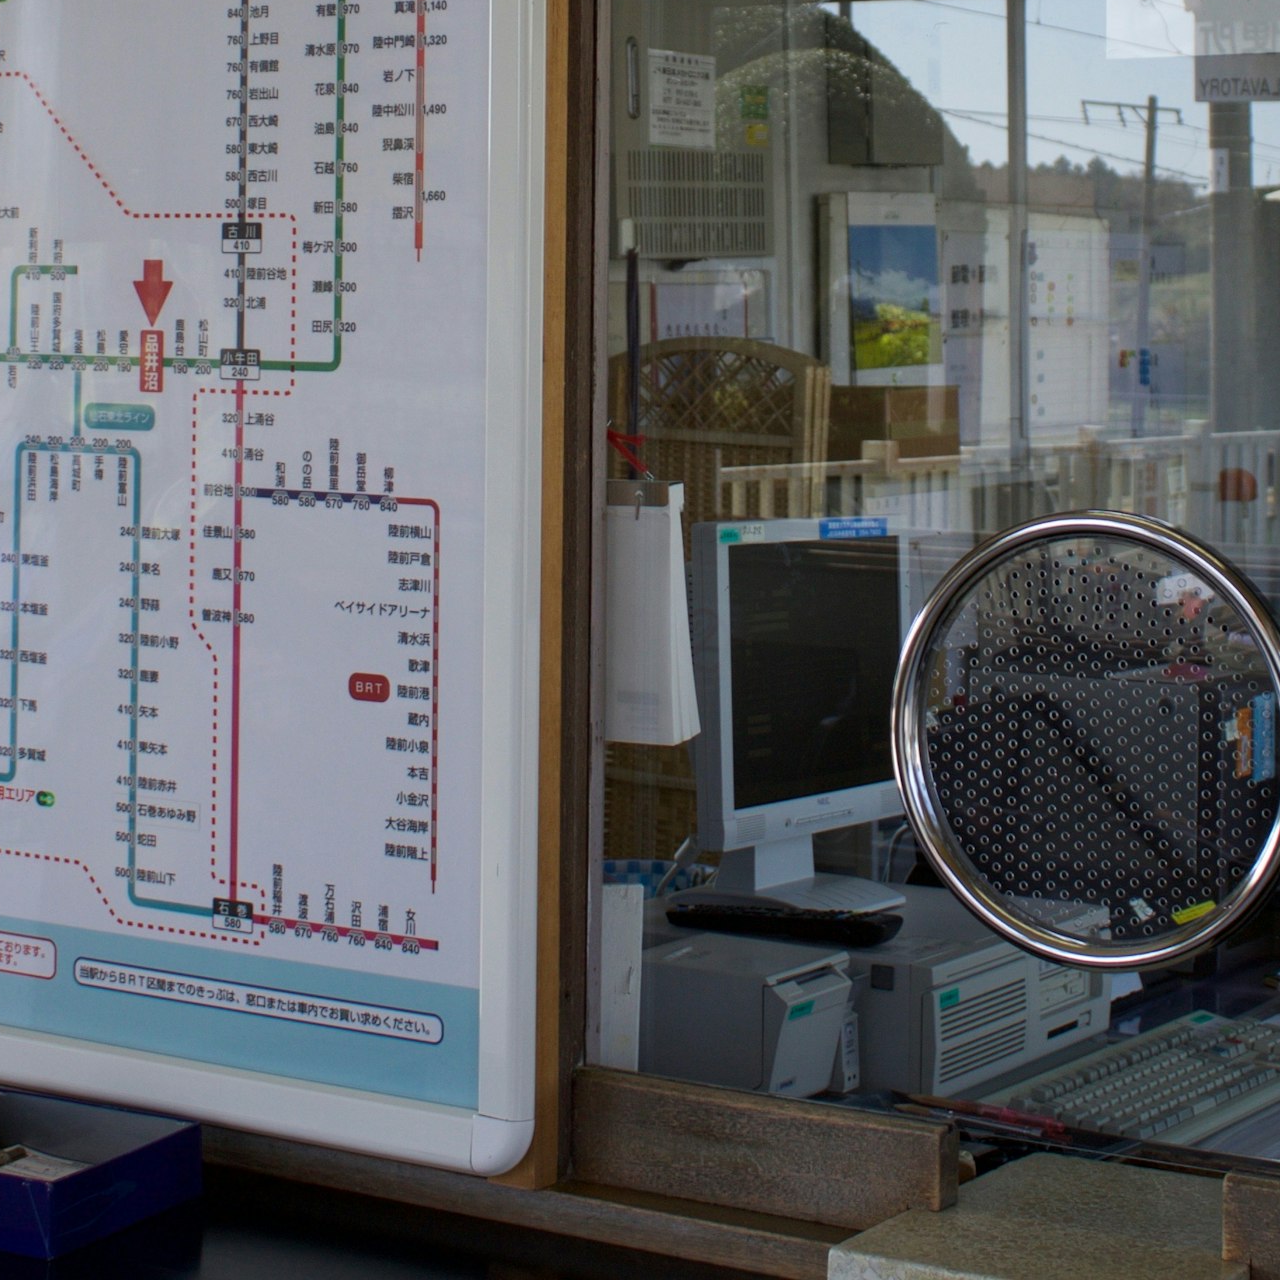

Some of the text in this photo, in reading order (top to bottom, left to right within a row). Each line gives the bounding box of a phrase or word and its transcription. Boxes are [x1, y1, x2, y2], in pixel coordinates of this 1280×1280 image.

[316, 4, 360, 16] 有壁 970
[394, 1, 447, 14] 真滝 1,140
[250, 32, 279, 45] 上野目
[373, 35, 447, 49] 陸中門崎 1,320
[304, 43, 359, 56] 清水原 970
[383, 69, 415, 82] 岩ノ下
[249, 88, 278, 100] 岩出山
[315, 83, 359, 96] 花泉 840
[372, 104, 446, 117] 陸中松川 1,490
[248, 115, 278, 127] 西大崎
[314, 122, 358, 135] 油島 840
[248, 142, 278, 155] 東大崎
[314, 162, 358, 174] 石越 760
[248, 170, 277, 182] 西古川
[392, 172, 413, 185] 柴宿
[422, 190, 446, 202] 1,660
[313, 201, 357, 214] 新田 580
[227, 225, 256, 238] 古川
[233, 240, 250, 251] 410
[340, 242, 357, 252] 500
[312, 280, 356, 293] 瀬峰 500
[311, 320, 356, 333] 田尻 320
[145, 333, 158, 391] 品井沼
[222, 352, 258, 365] 小牛田
[232, 367, 248, 378] 240
[388, 524, 431, 539] 陸前横山
[388, 550, 431, 566] 陸前戸倉
[398, 578, 430, 593] 志津川
[334, 600, 430, 618] ベイサイドアリーナ
[397, 632, 430, 646] 清水浜
[408, 659, 430, 673] 歌津
[355, 681, 383, 694] BRT
[397, 684, 430, 700] 陸前港
[139, 705, 158, 718] 矢本
[408, 712, 429, 727] 蔵内
[386, 736, 429, 754] 陸前小泉
[407, 766, 429, 781] 本吉
[396, 792, 429, 807] 小金沢
[385, 818, 428, 833] 大谷海岸
[385, 843, 428, 860] 陸前階上
[218, 902, 248, 918] 石巻
[224, 918, 241, 930] 580
[405, 908, 416, 935] 女川
[401, 941, 420, 954] 840
